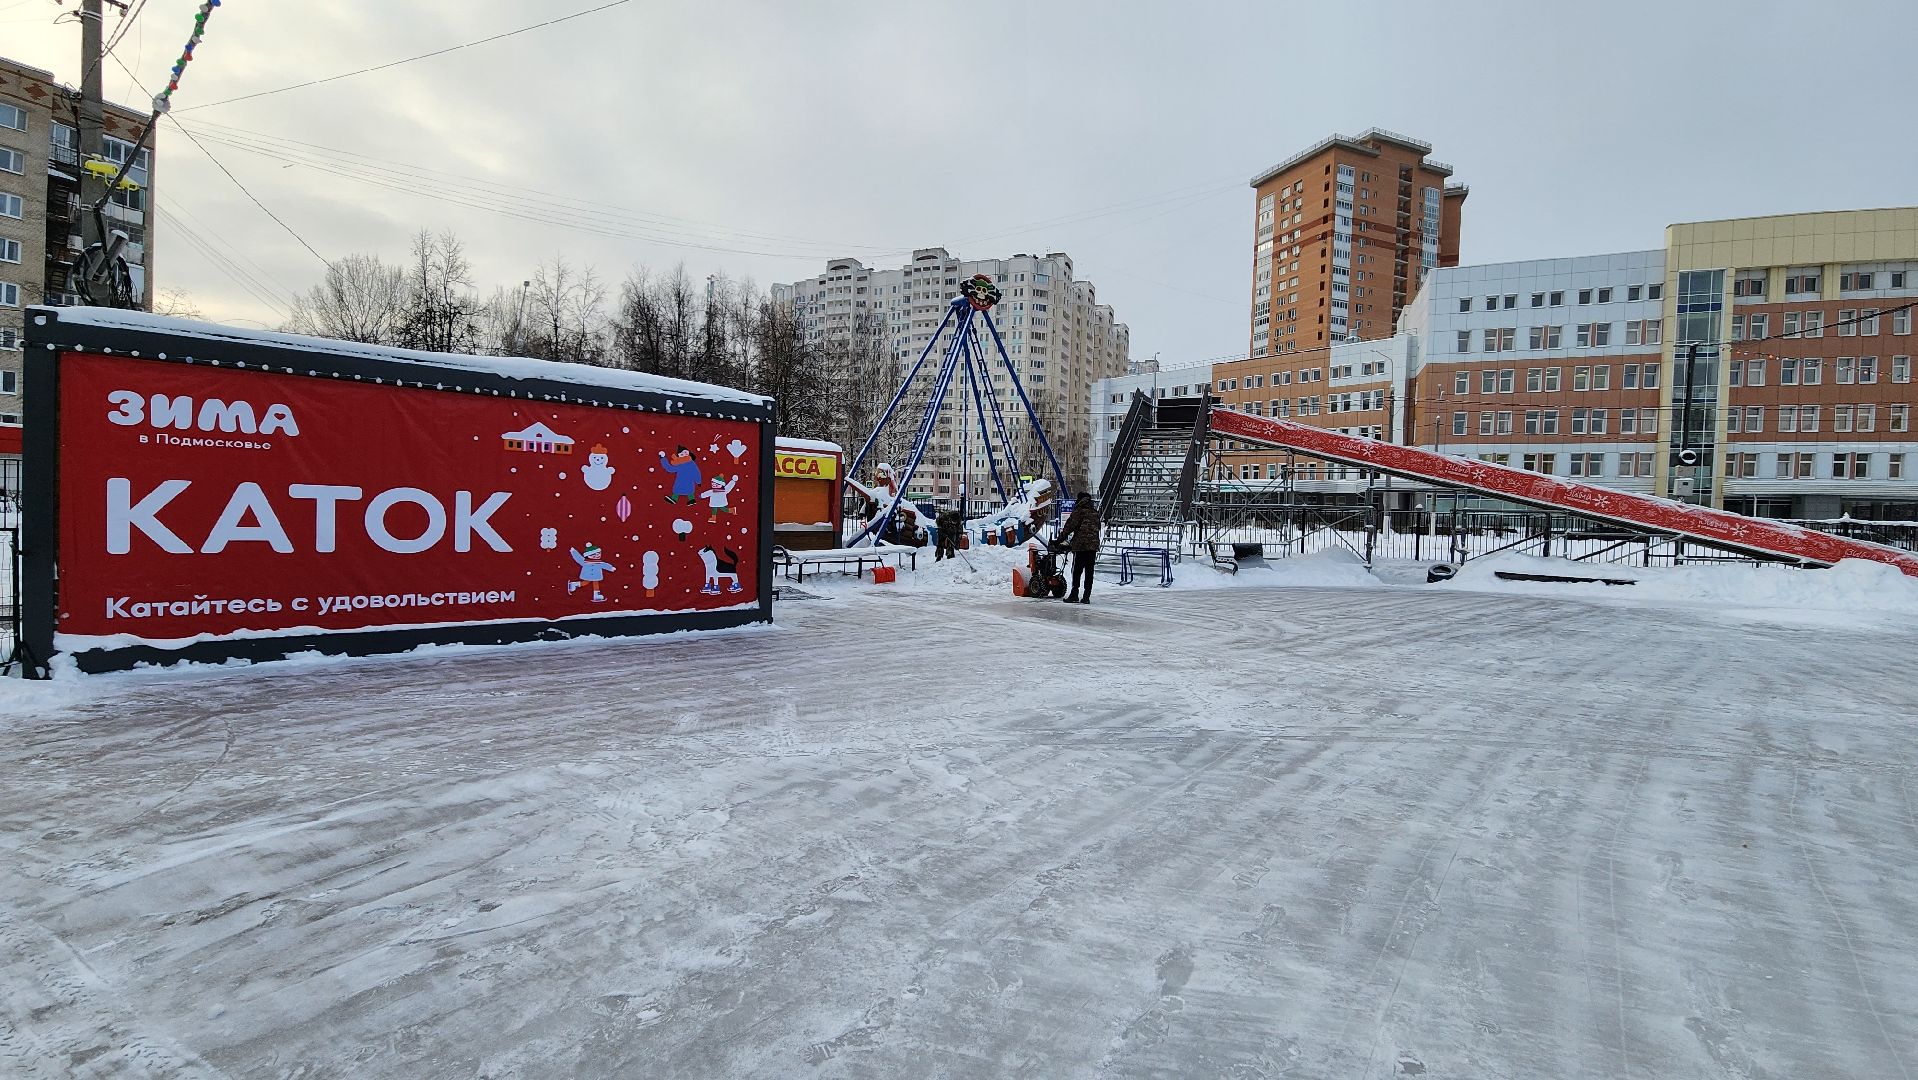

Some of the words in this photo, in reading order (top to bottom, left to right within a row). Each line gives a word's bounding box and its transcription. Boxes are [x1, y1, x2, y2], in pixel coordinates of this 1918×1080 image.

[107, 389, 300, 437] ЗИМА
[139, 434, 149, 444] в
[156, 433, 272, 450] Подмосковье
[106, 477, 514, 555] КАТОК
[106, 594, 283, 619] Катайтесь
[291, 597, 309, 611] с
[317, 590, 516, 616] удовольствием
